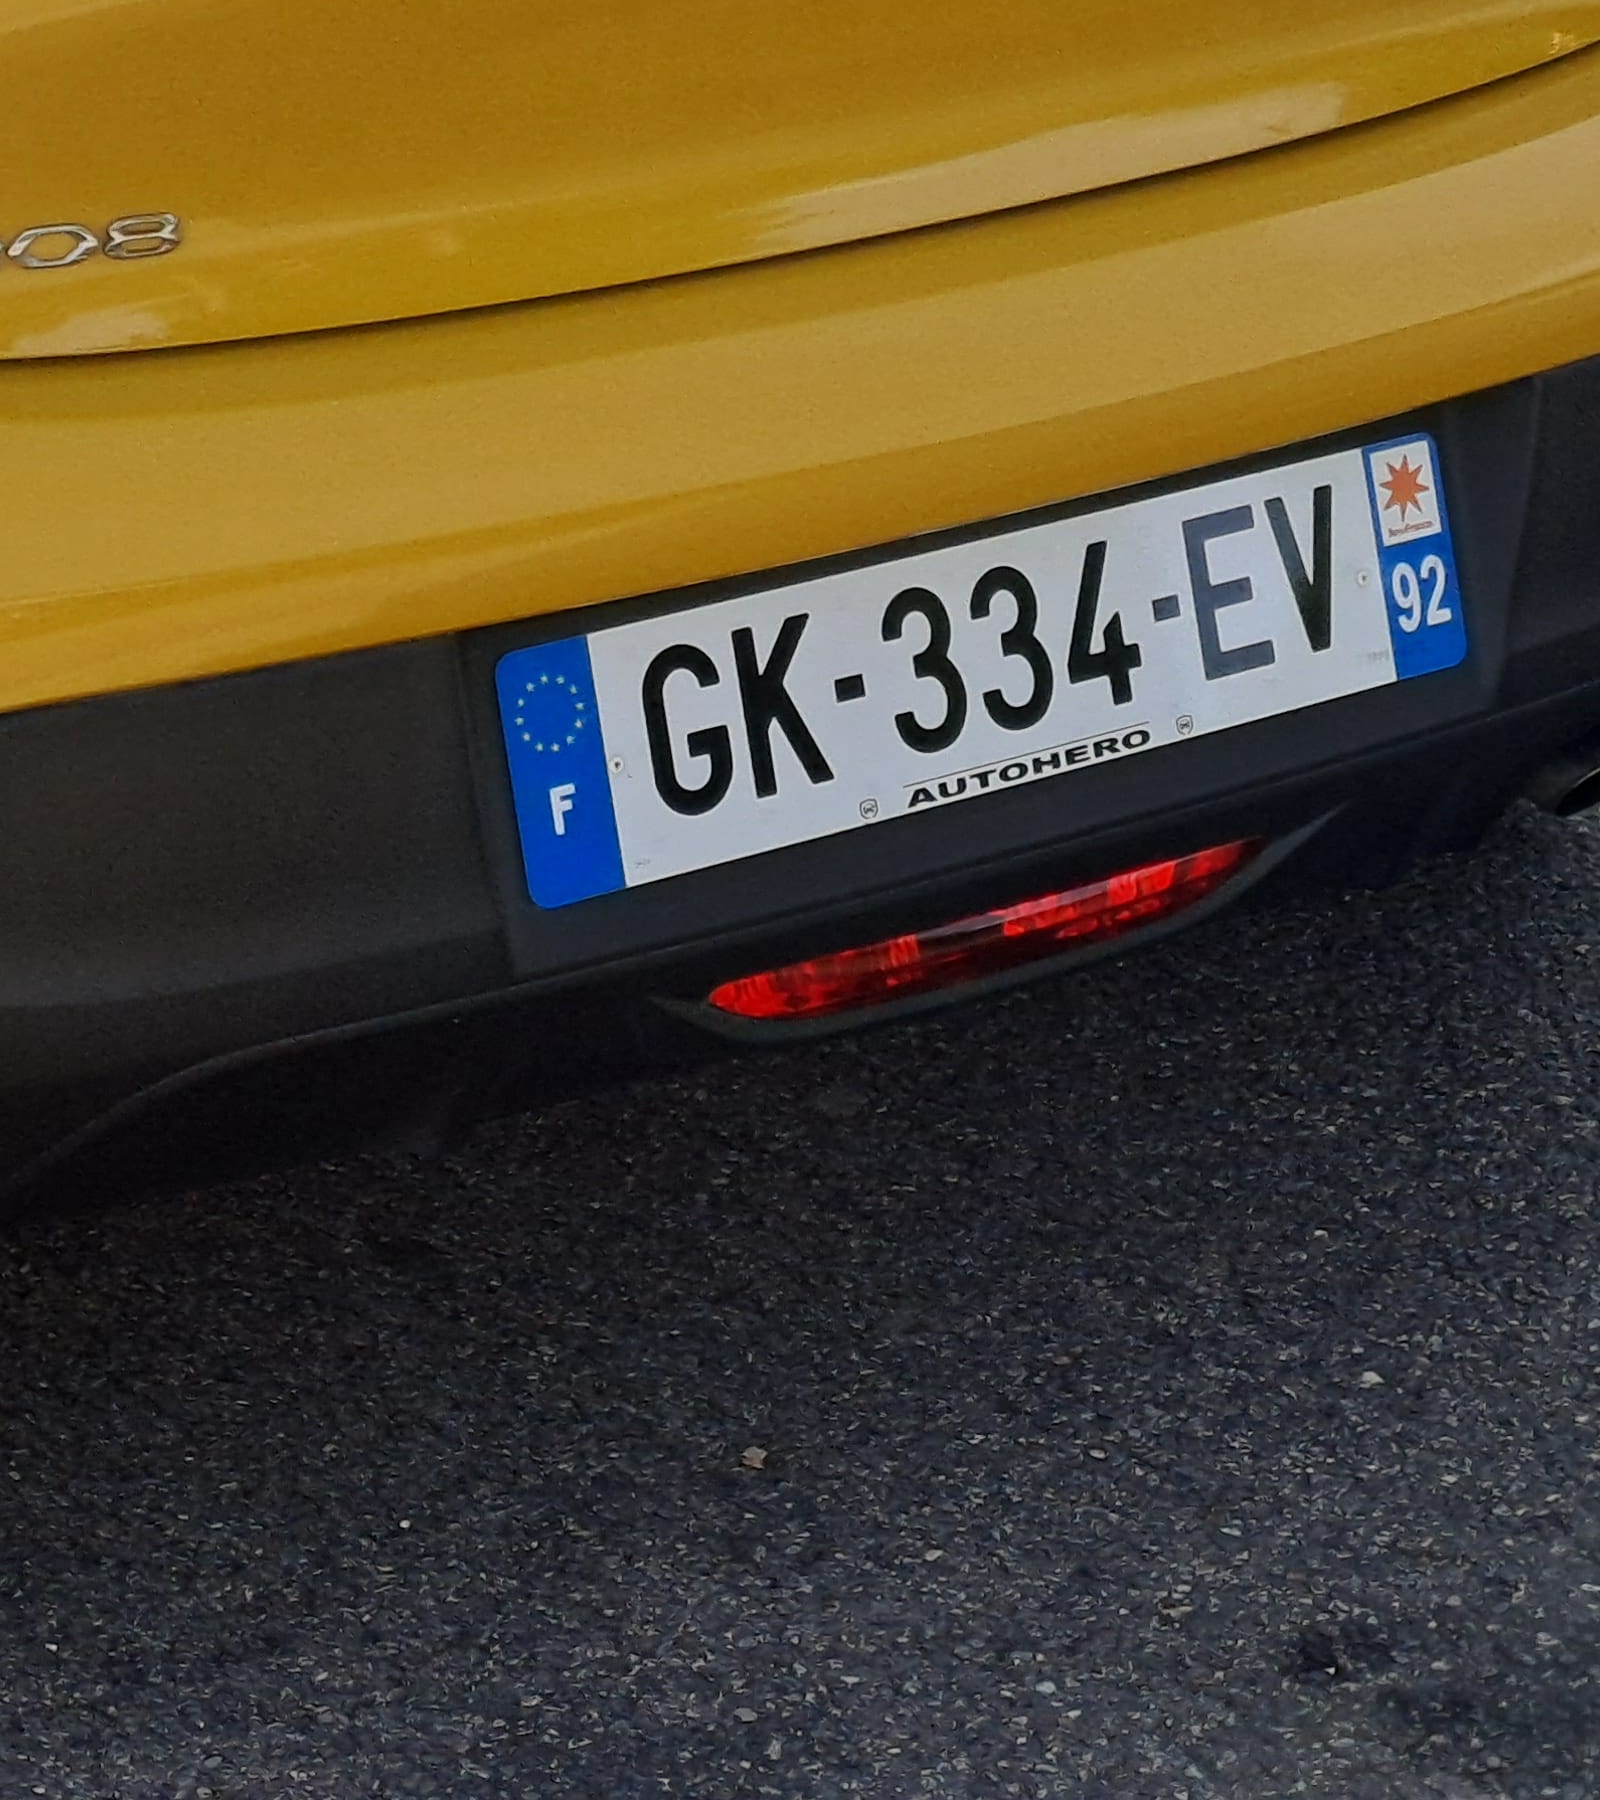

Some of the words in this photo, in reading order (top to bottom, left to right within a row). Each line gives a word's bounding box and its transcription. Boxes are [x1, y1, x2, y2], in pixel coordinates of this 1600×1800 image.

[1392, 553, 1453, 634] 92
[641, 484, 1333, 816] GK-334-EV
[907, 727, 1152, 808] AUTOHERO
[550, 783, 577, 837] F
